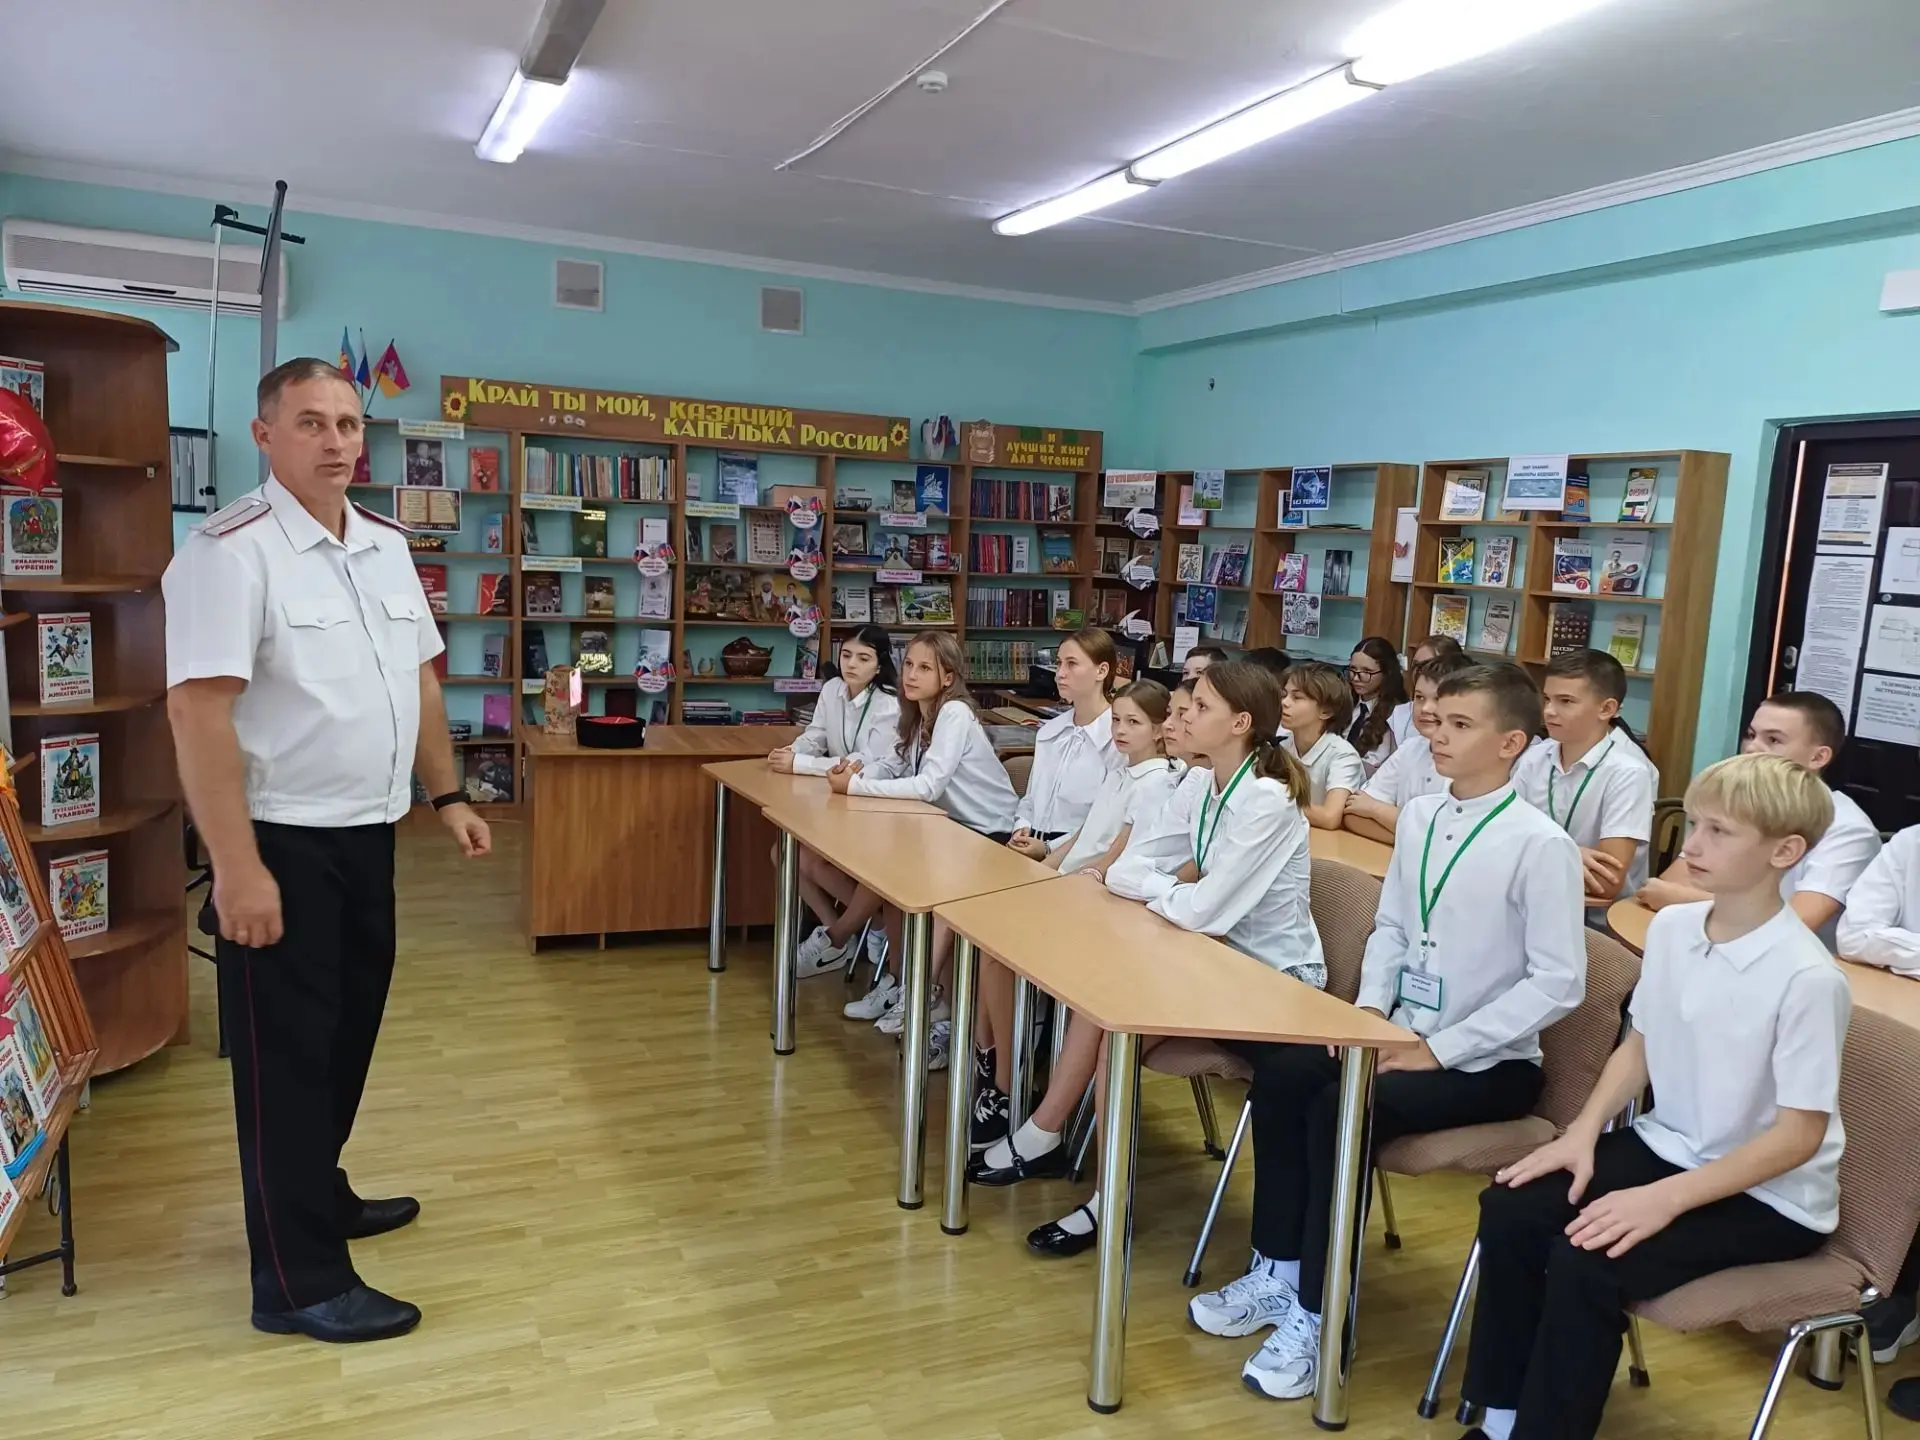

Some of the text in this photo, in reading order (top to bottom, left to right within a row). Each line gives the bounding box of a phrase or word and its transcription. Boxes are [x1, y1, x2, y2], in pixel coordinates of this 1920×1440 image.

[549, 391, 586, 411] ТЫ
[663, 417, 888, 452] КАПЕЛЬКА РОССИИ
[1006, 442, 1090, 456] ЛУЧШИХ КНИГ
[1010, 453, 1085, 467] ДЛЯ ЧТЕНИЯ
[1579, 580, 1584, 588] 7
